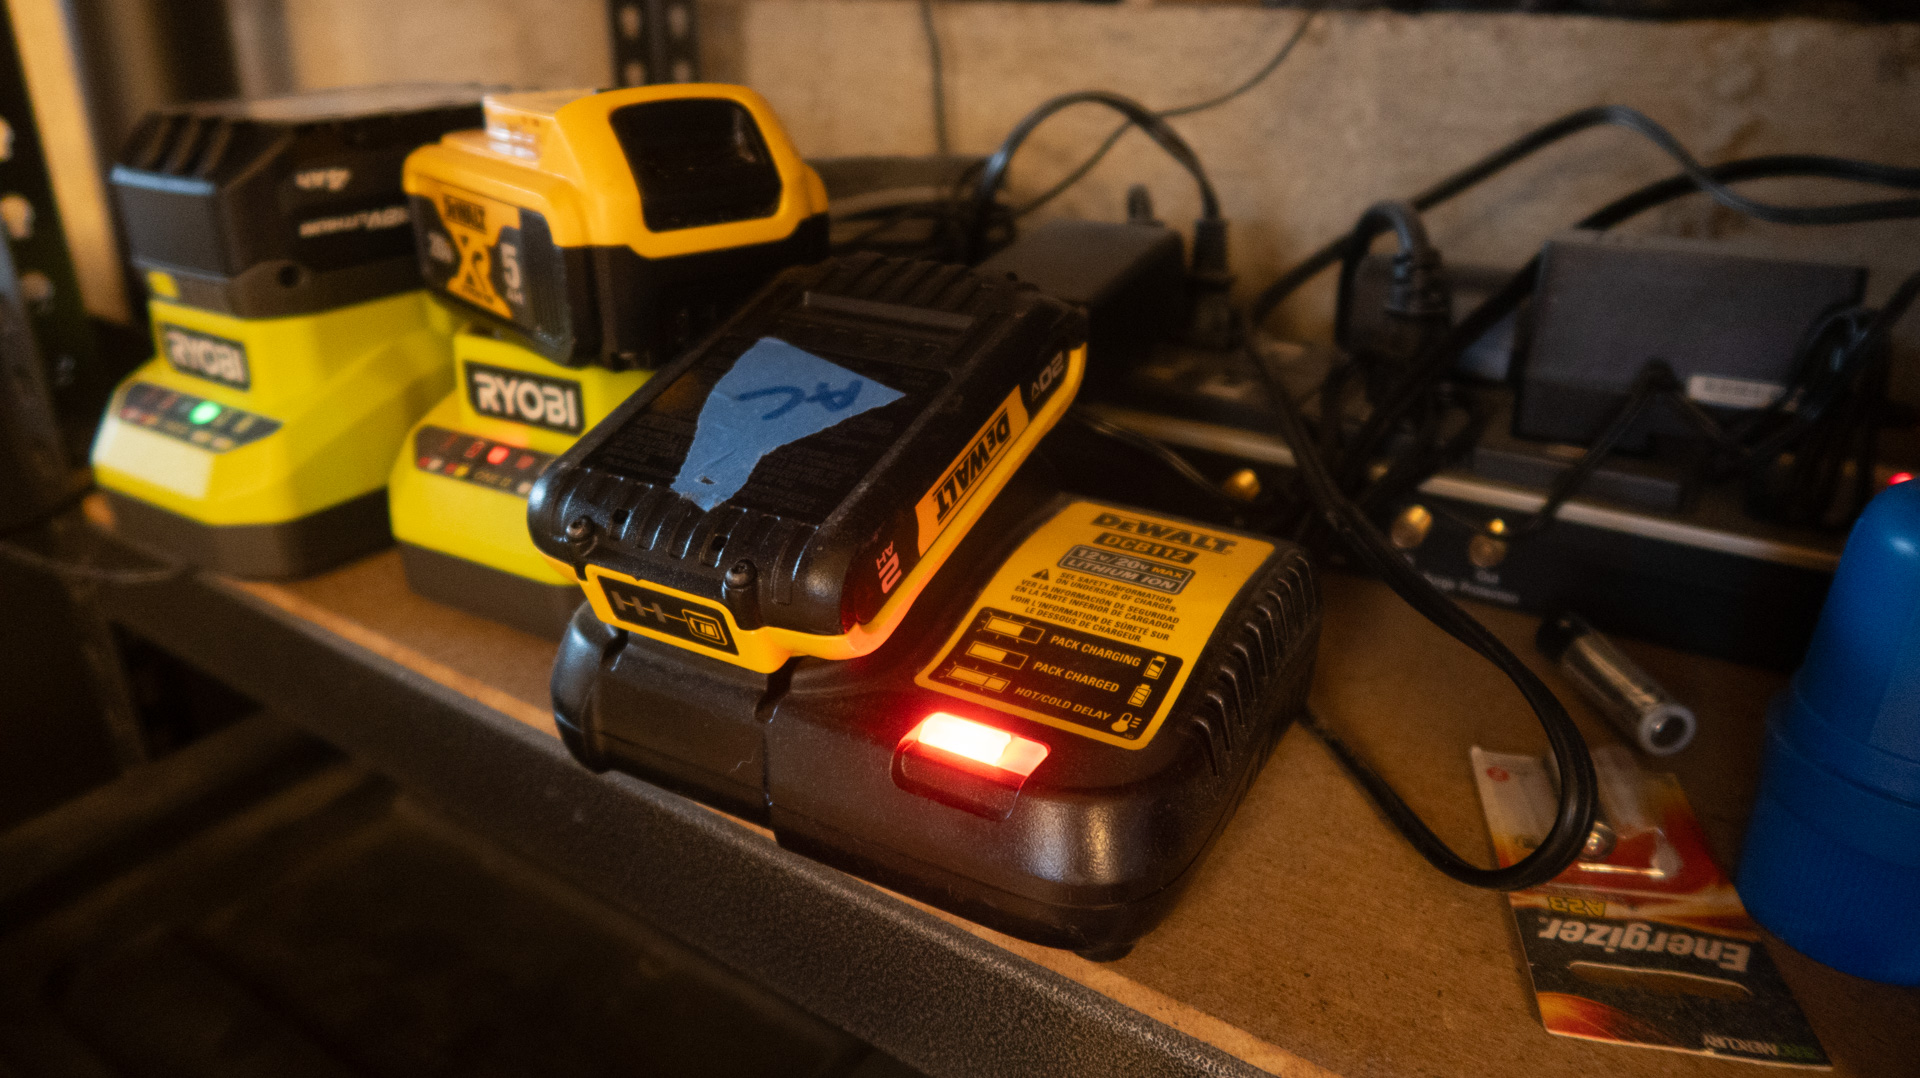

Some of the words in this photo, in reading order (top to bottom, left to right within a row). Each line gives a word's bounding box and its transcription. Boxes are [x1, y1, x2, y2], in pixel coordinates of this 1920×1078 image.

[500, 243, 521, 290] 5
[167, 331, 245, 382] RYOBI
[474, 372, 578, 427] RYOBI
[933, 407, 1012, 525] DEWALT
[1090, 512, 1237, 552] DEWALT
[1104, 535, 1188, 561] DCB112
[878, 552, 902, 594] 2
[1059, 572, 1075, 580] SEE
[1077, 576, 1108, 588] SAFETY
[1110, 584, 1173, 604] INFORMATION
[1067, 558, 1139, 580] LITHIUM
[1140, 576, 1175, 590] ION
[1151, 566, 1184, 579] MAX
[1015, 585, 1028, 593] EN
[1041, 592, 1068, 604] PARTE
[1069, 598, 1108, 614] INFERIOR
[1110, 609, 1122, 617] DE
[1123, 612, 1175, 631] CARGADOR.
[1021, 579, 1036, 588] VER
[1038, 583, 1049, 591] LA
[1051, 586, 1111, 607] INFORMACIÓN
[1113, 602, 1125, 610] DE
[1127, 605, 1180, 624] SEGURIDAD
[1070, 581, 1119, 597] UNDERSIDE
[1121, 593, 1133, 601] OF
[1134, 597, 1177, 613] CHARGER.
[1010, 595, 1031, 605] VOIR
[1031, 599, 1099, 622] L'INFORMATION
[1101, 618, 1113, 626] DE
[1114, 621, 1149, 635] SÛRETÉ
[1151, 630, 1170, 641] SUR
[1025, 606, 1035, 614] LE
[1036, 609, 1077, 625] DESSOUS
[1078, 620, 1091, 628] DE
[1092, 624, 1142, 642] CHARGEUR.
[1050, 635, 1080, 650] PACK
[1081, 643, 1141, 667] CHARGING
[1032, 661, 1064, 677] PACK
[1064, 670, 1120, 692] CHARGED
[1015, 687, 1072, 709] HOT/COLD
[1072, 703, 1112, 720] DELAY
[1547, 896, 1606, 917] A23
[1538, 918, 1749, 972] Energizer
[1704, 1034, 1779, 1056] MERCURY
